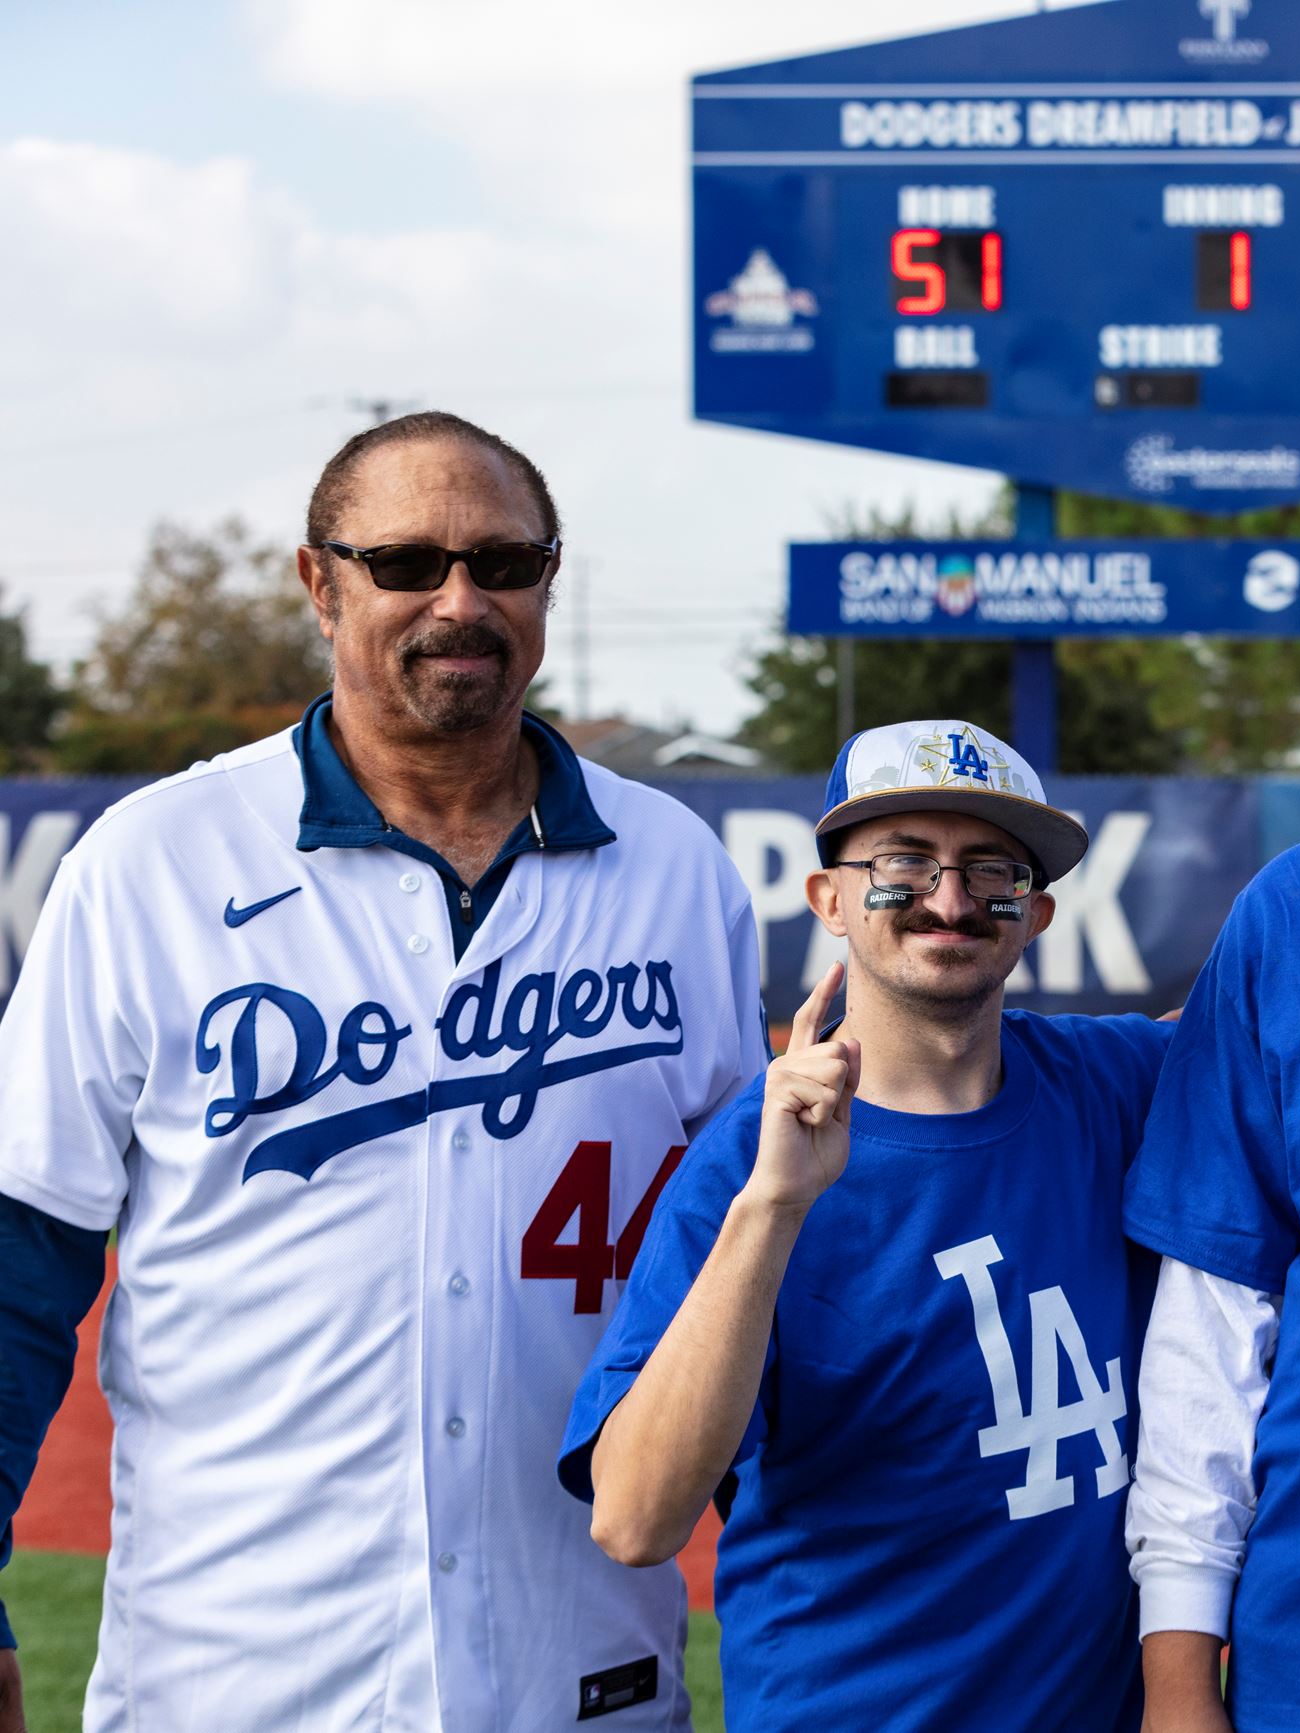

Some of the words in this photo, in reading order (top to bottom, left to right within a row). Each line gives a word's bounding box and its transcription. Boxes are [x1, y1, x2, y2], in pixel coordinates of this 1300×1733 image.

[841, 101, 1021, 147] DODGERS
[1027, 101, 1263, 147] DREAMFIELD
[839, 552, 938, 600] SAN
[974, 552, 1167, 600] MANUEL
[947, 733, 988, 781] LA
[870, 892, 907, 903] RAIDERS
[195, 958, 684, 1140] Dodgers
[933, 1234, 1130, 1521] LA
